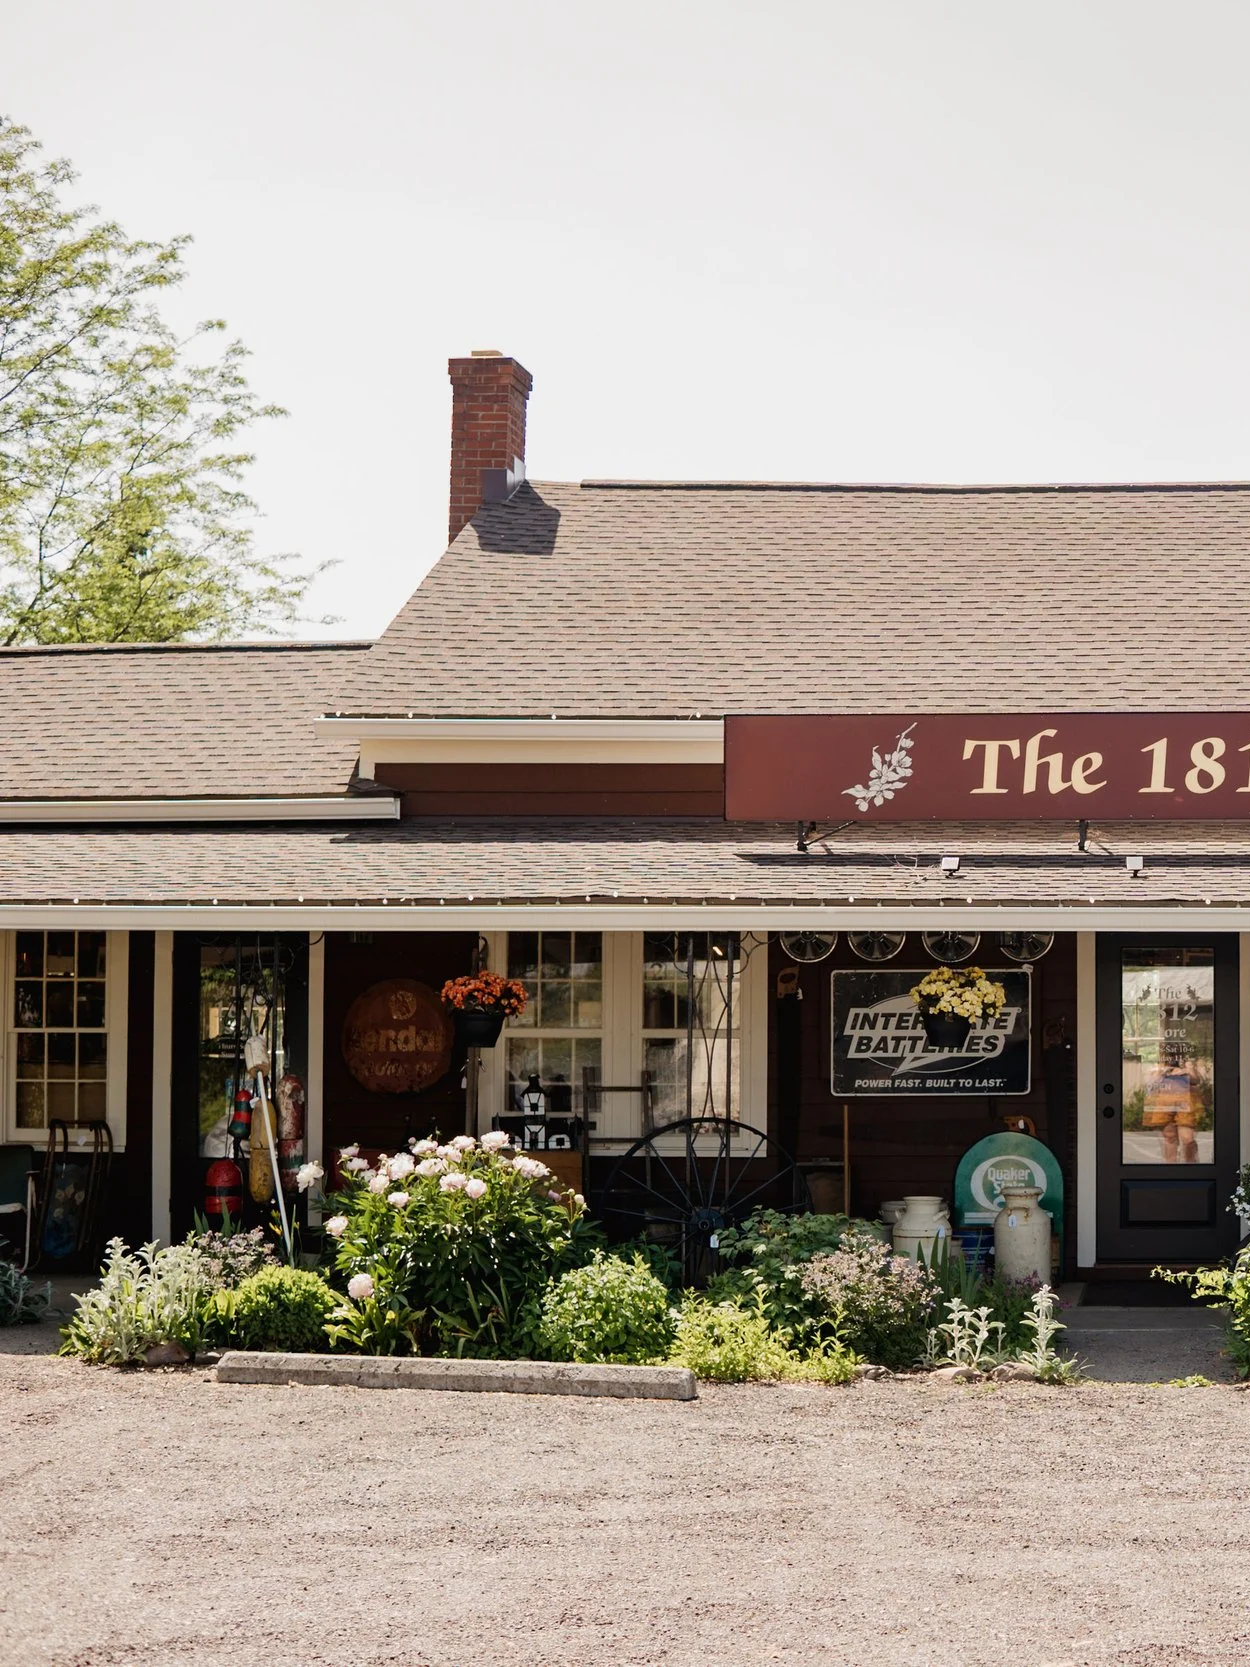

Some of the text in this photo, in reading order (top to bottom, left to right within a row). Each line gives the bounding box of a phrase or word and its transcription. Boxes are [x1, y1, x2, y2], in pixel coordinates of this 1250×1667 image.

[963, 728, 1107, 795] The
[1153, 985, 1182, 999] The
[1155, 999, 1199, 1021] 812
[850, 1012, 1010, 1031] INTERTE
[1163, 1027, 1187, 1039] ore
[854, 1035, 1001, 1054] BATTEES
[854, 1079, 893, 1088] POWER
[894, 1079, 923, 1088] FAST.
[925, 1078, 956, 1087] BUILT
[958, 1078, 973, 1087] TO
[987, 1167, 1031, 1184] Quaker
